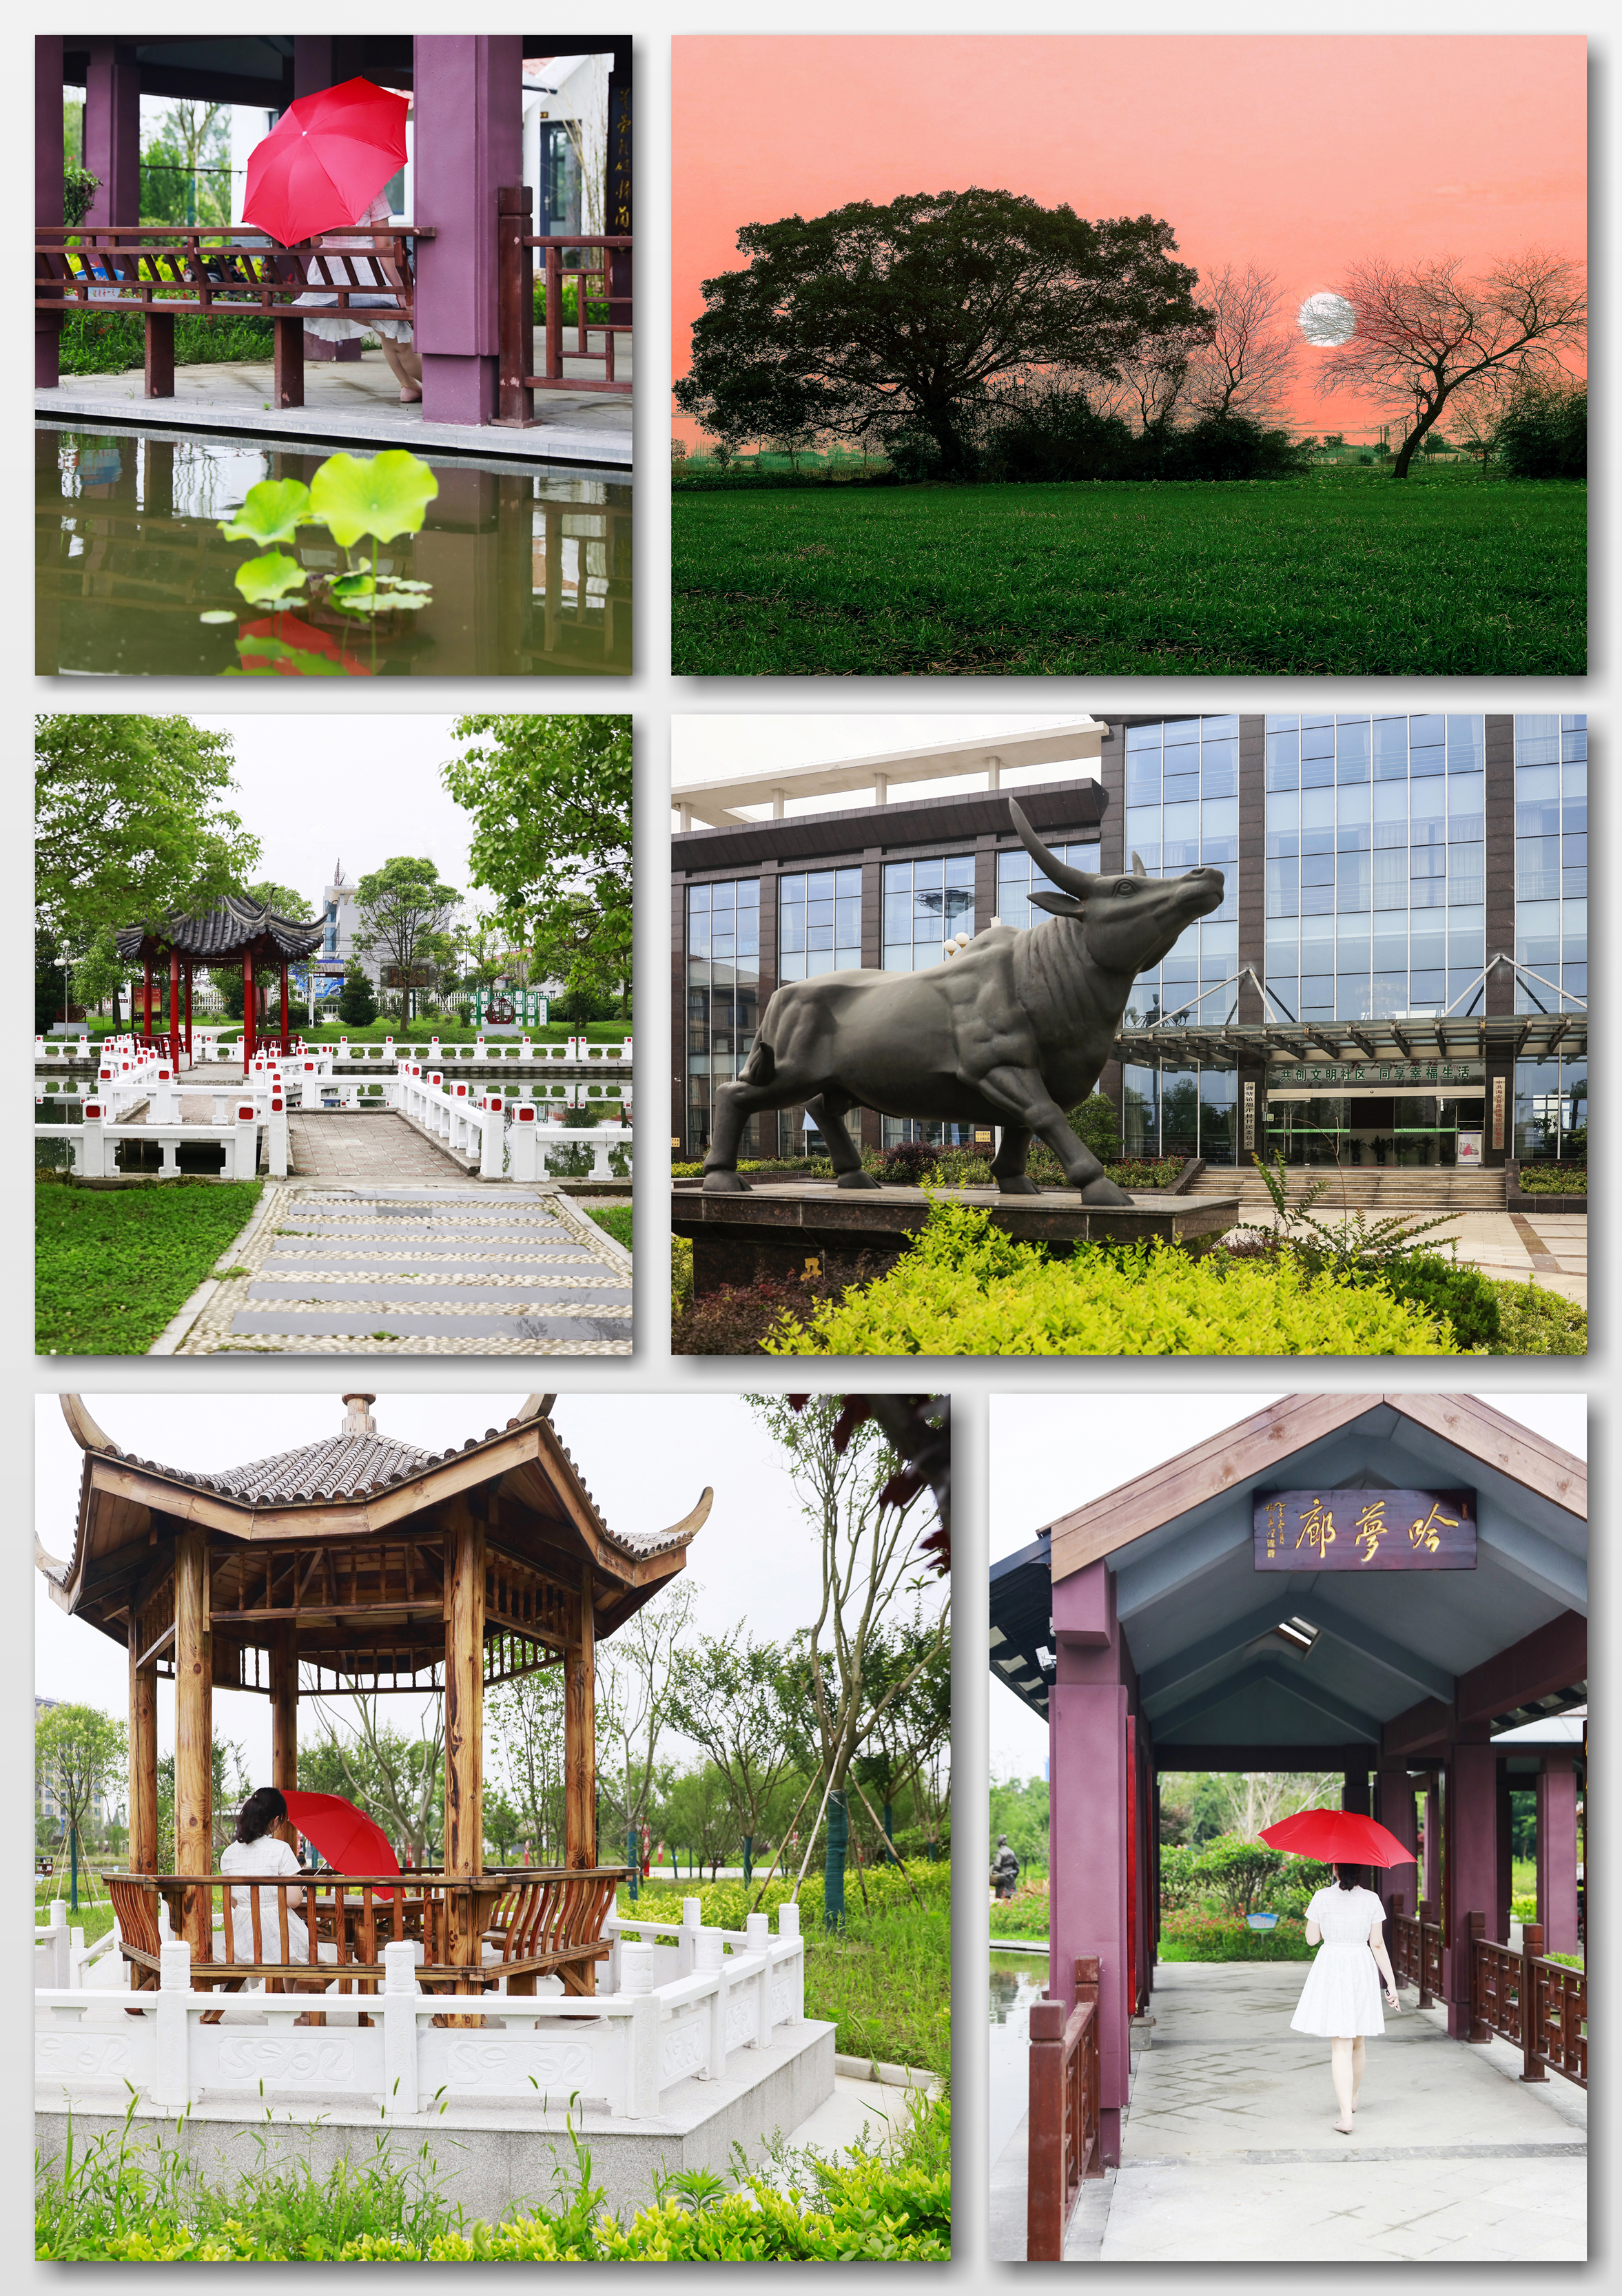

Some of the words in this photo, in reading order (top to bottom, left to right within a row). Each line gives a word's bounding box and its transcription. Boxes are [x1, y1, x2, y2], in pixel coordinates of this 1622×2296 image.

[1280, 1068, 1366, 1083] 共创文明社区
[1379, 1066, 1470, 1080] 同享幸福生活
